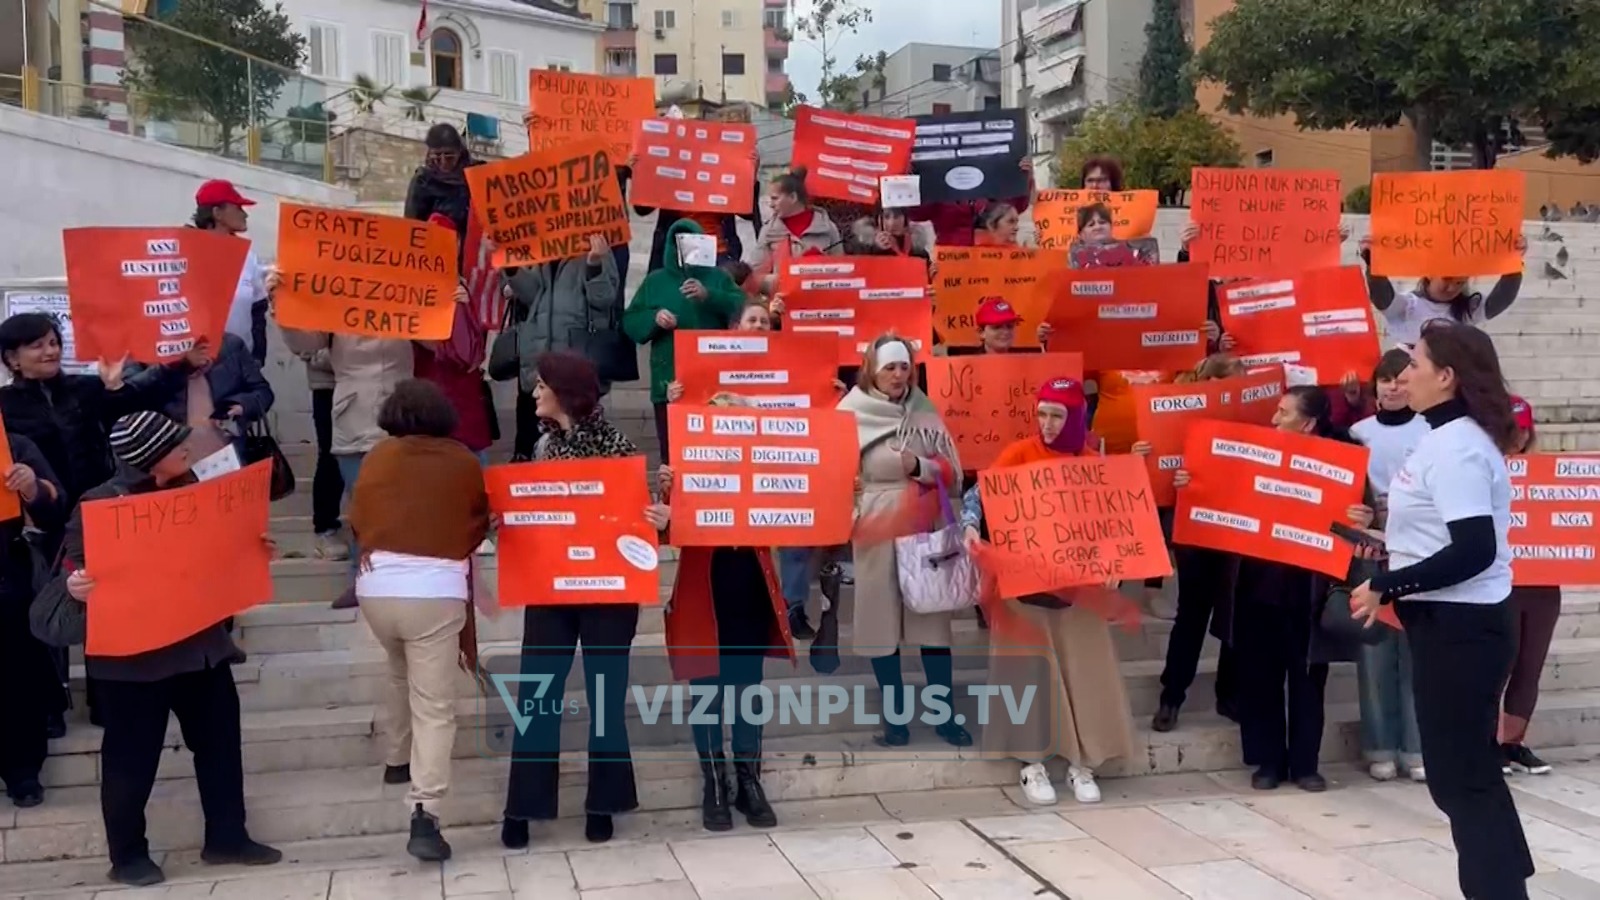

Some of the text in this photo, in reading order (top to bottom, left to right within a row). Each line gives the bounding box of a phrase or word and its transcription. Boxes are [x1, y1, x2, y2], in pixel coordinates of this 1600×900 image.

[538, 74, 589, 96] DHUNA
[561, 97, 618, 117] GRAVE
[486, 151, 609, 203] MBROJTJA
[1196, 172, 1341, 193] DHUNA NUK NDALET
[487, 183, 608, 225] E GRAVE NUK
[1202, 199, 1222, 212] ME
[1303, 199, 1328, 212] POR
[545, 204, 623, 233] SHPENZIM
[410, 227, 428, 249] E
[1200, 223, 1226, 241] ME
[1242, 226, 1282, 242] DIJE
[506, 245, 537, 263] POR
[1214, 244, 1272, 263] ARSIM
[947, 315, 974, 329] KRI
[1153, 396, 1204, 410] FORCA
[714, 418, 755, 431] JAPIM
[768, 420, 806, 433] FUND
[690, 476, 727, 488] NDAJ
[984, 464, 1110, 497] NUK KA ASNJE
[1531, 487, 1600, 499] PARANDA
[1004, 488, 1150, 524] JUSTIFIKIM
[704, 511, 812, 525] DHE VAJZAVE!
[1559, 514, 1590, 525] NGA
[993, 519, 1135, 551] PER DHUNEN
[1053, 545, 1100, 565] GRAVE
[1117, 542, 1146, 557] DHE
[1513, 545, 1594, 559] OMUNITETI
